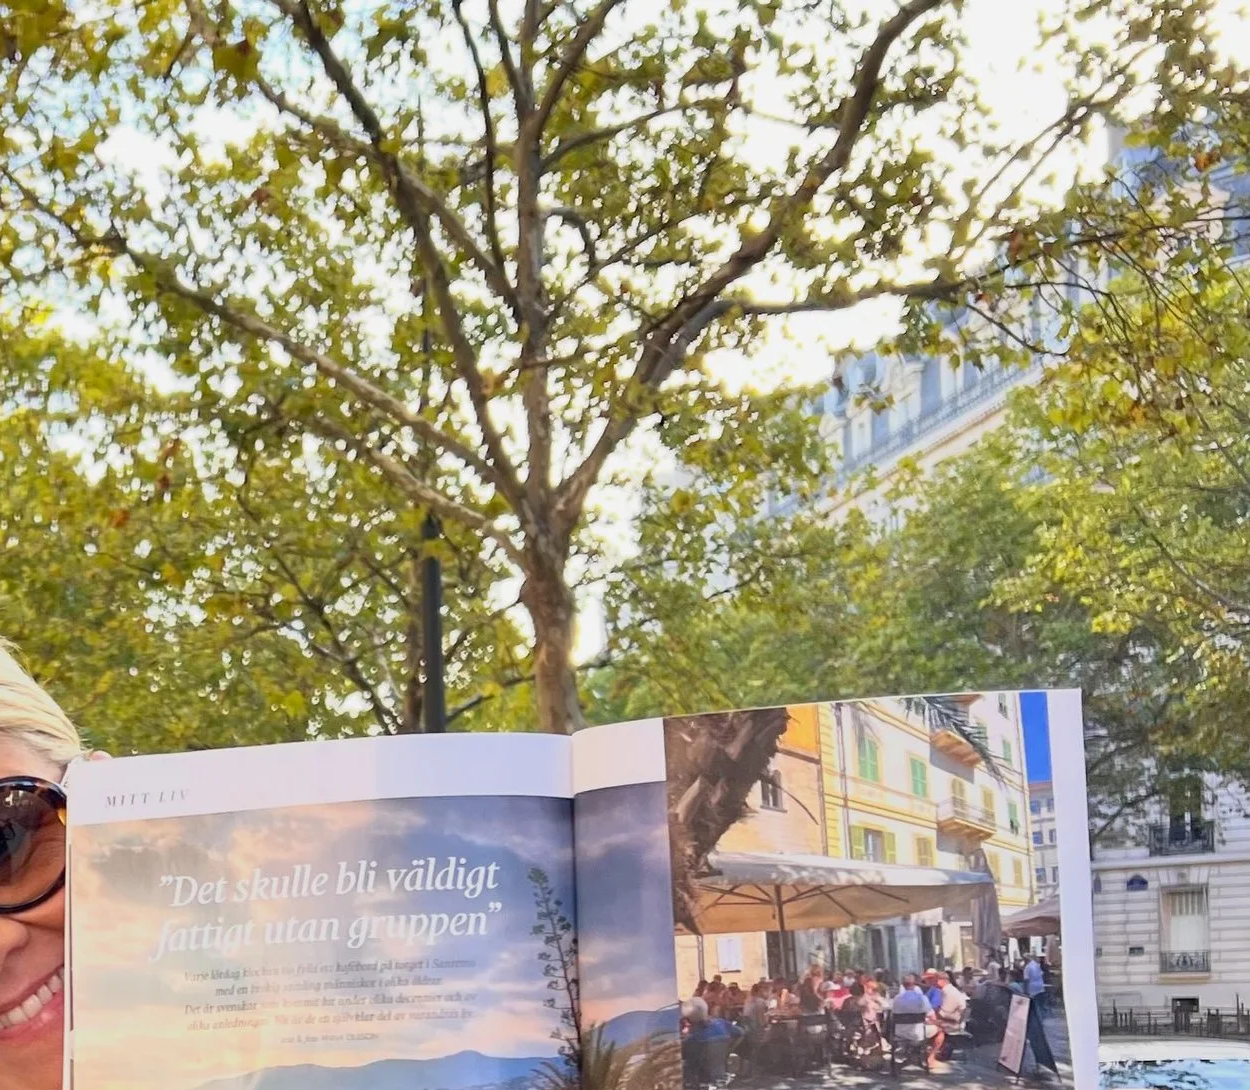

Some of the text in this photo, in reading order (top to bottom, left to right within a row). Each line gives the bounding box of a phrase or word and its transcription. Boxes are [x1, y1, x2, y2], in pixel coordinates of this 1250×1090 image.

[233, 864, 329, 901] skulle
[335, 859, 378, 895] bli
[386, 856, 500, 899] väldigt
[149, 916, 255, 963] fattigt
[264, 915, 340, 945] utan
